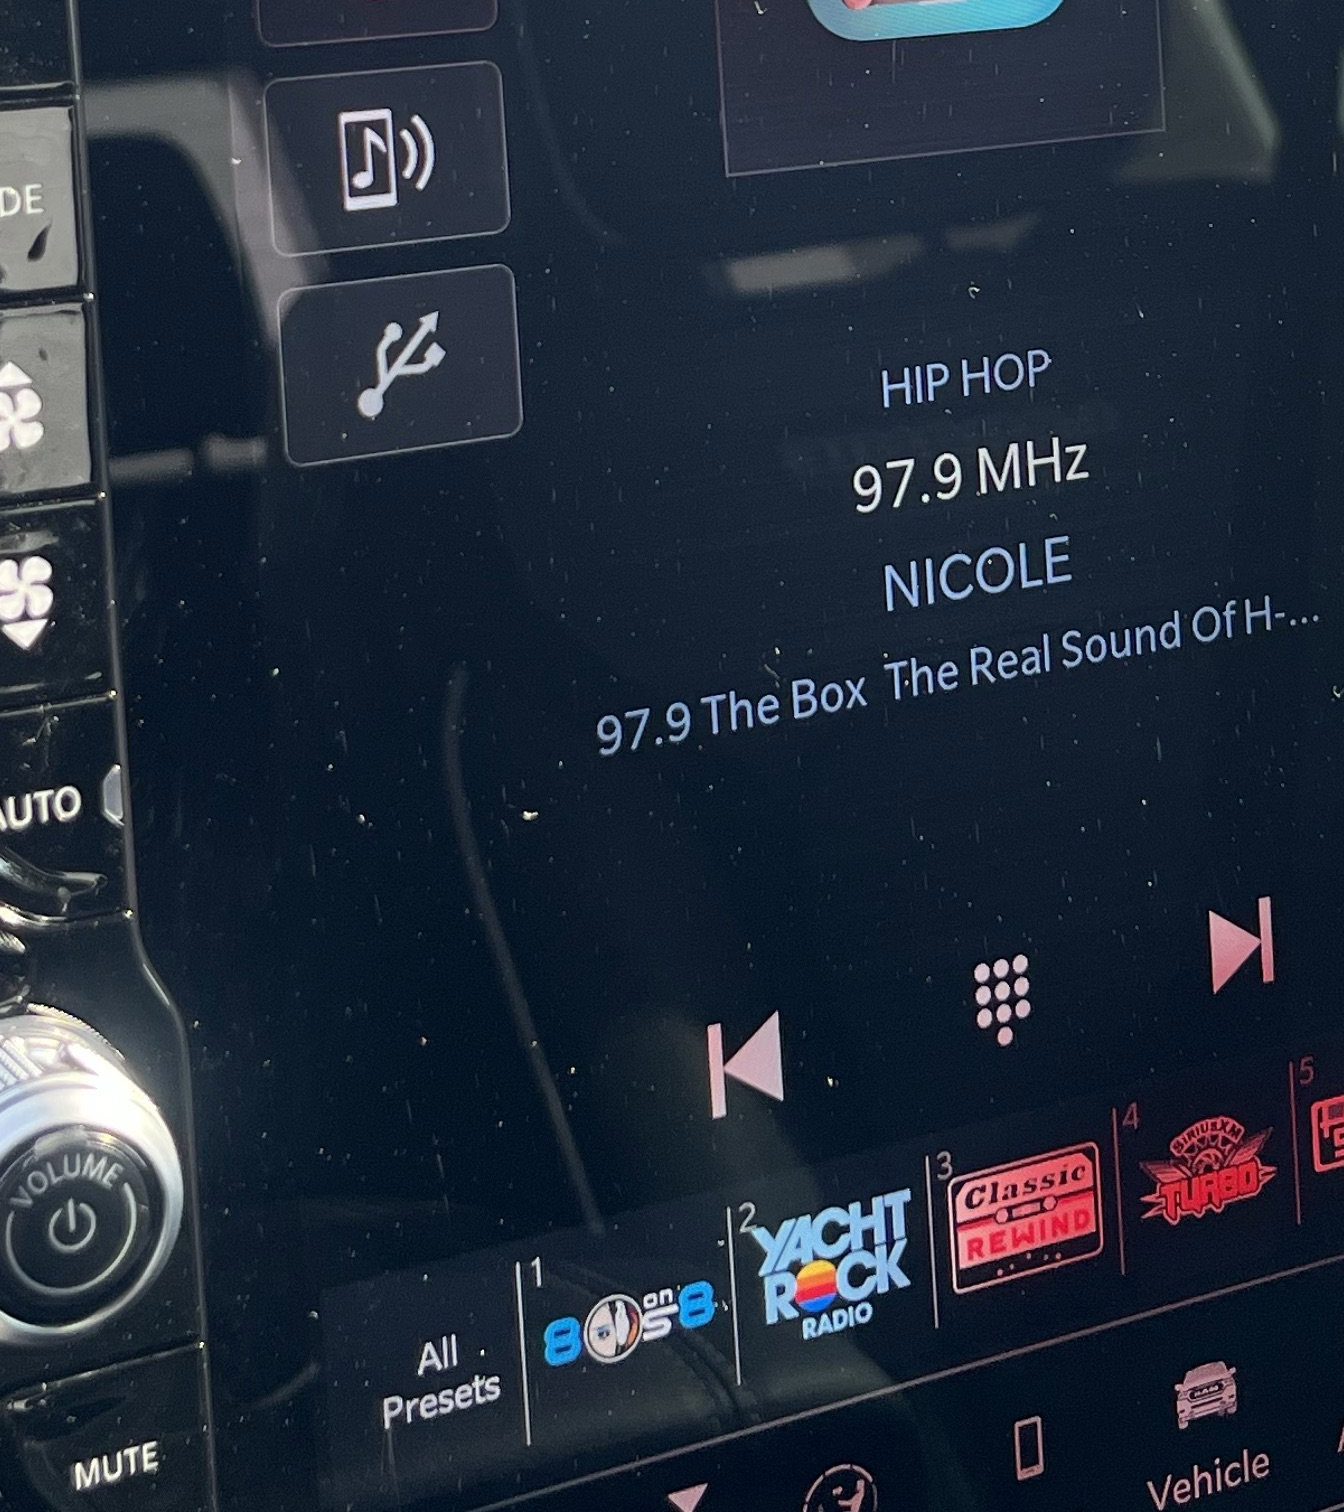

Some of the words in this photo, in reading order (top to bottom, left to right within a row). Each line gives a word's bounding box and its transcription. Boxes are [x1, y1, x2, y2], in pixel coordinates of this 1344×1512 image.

[882, 363, 950, 408] HIP
[961, 348, 1052, 397] HOP
[852, 452, 963, 514] 97.9
[977, 436, 1091, 495] MHz
[884, 535, 1073, 612] NICOLE
[596, 702, 692, 756] 97.9
[700, 689, 781, 735] The
[791, 675, 868, 720] Box
[883, 657, 960, 700] The
[969, 633, 1052, 685] Real
[1061, 609, 1183, 669] Sound
[1191, 598, 1239, 642] Of
[1299, 1055, 1315, 1085] 5
[1121, 1102, 1141, 1133] 4
[9, 1154, 126, 1210] VOLUME
[936, 1150, 953, 1181] 3
[964, 1163, 1087, 1210] Classic
[1159, 1159, 1259, 1222] TURBO
[738, 1201, 757, 1234] 2
[751, 1187, 913, 1278] YACHT
[967, 1208, 1092, 1262] REWIND
[530, 1255, 543, 1288] 1
[762, 1237, 912, 1326] ROCK
[801, 1300, 874, 1341] RADIO
[416, 1334, 459, 1376] All
[382, 1372, 503, 1430] Presets
[72, 1440, 160, 1490] MUTE
[1146, 1448, 1272, 1512] Vehicle
